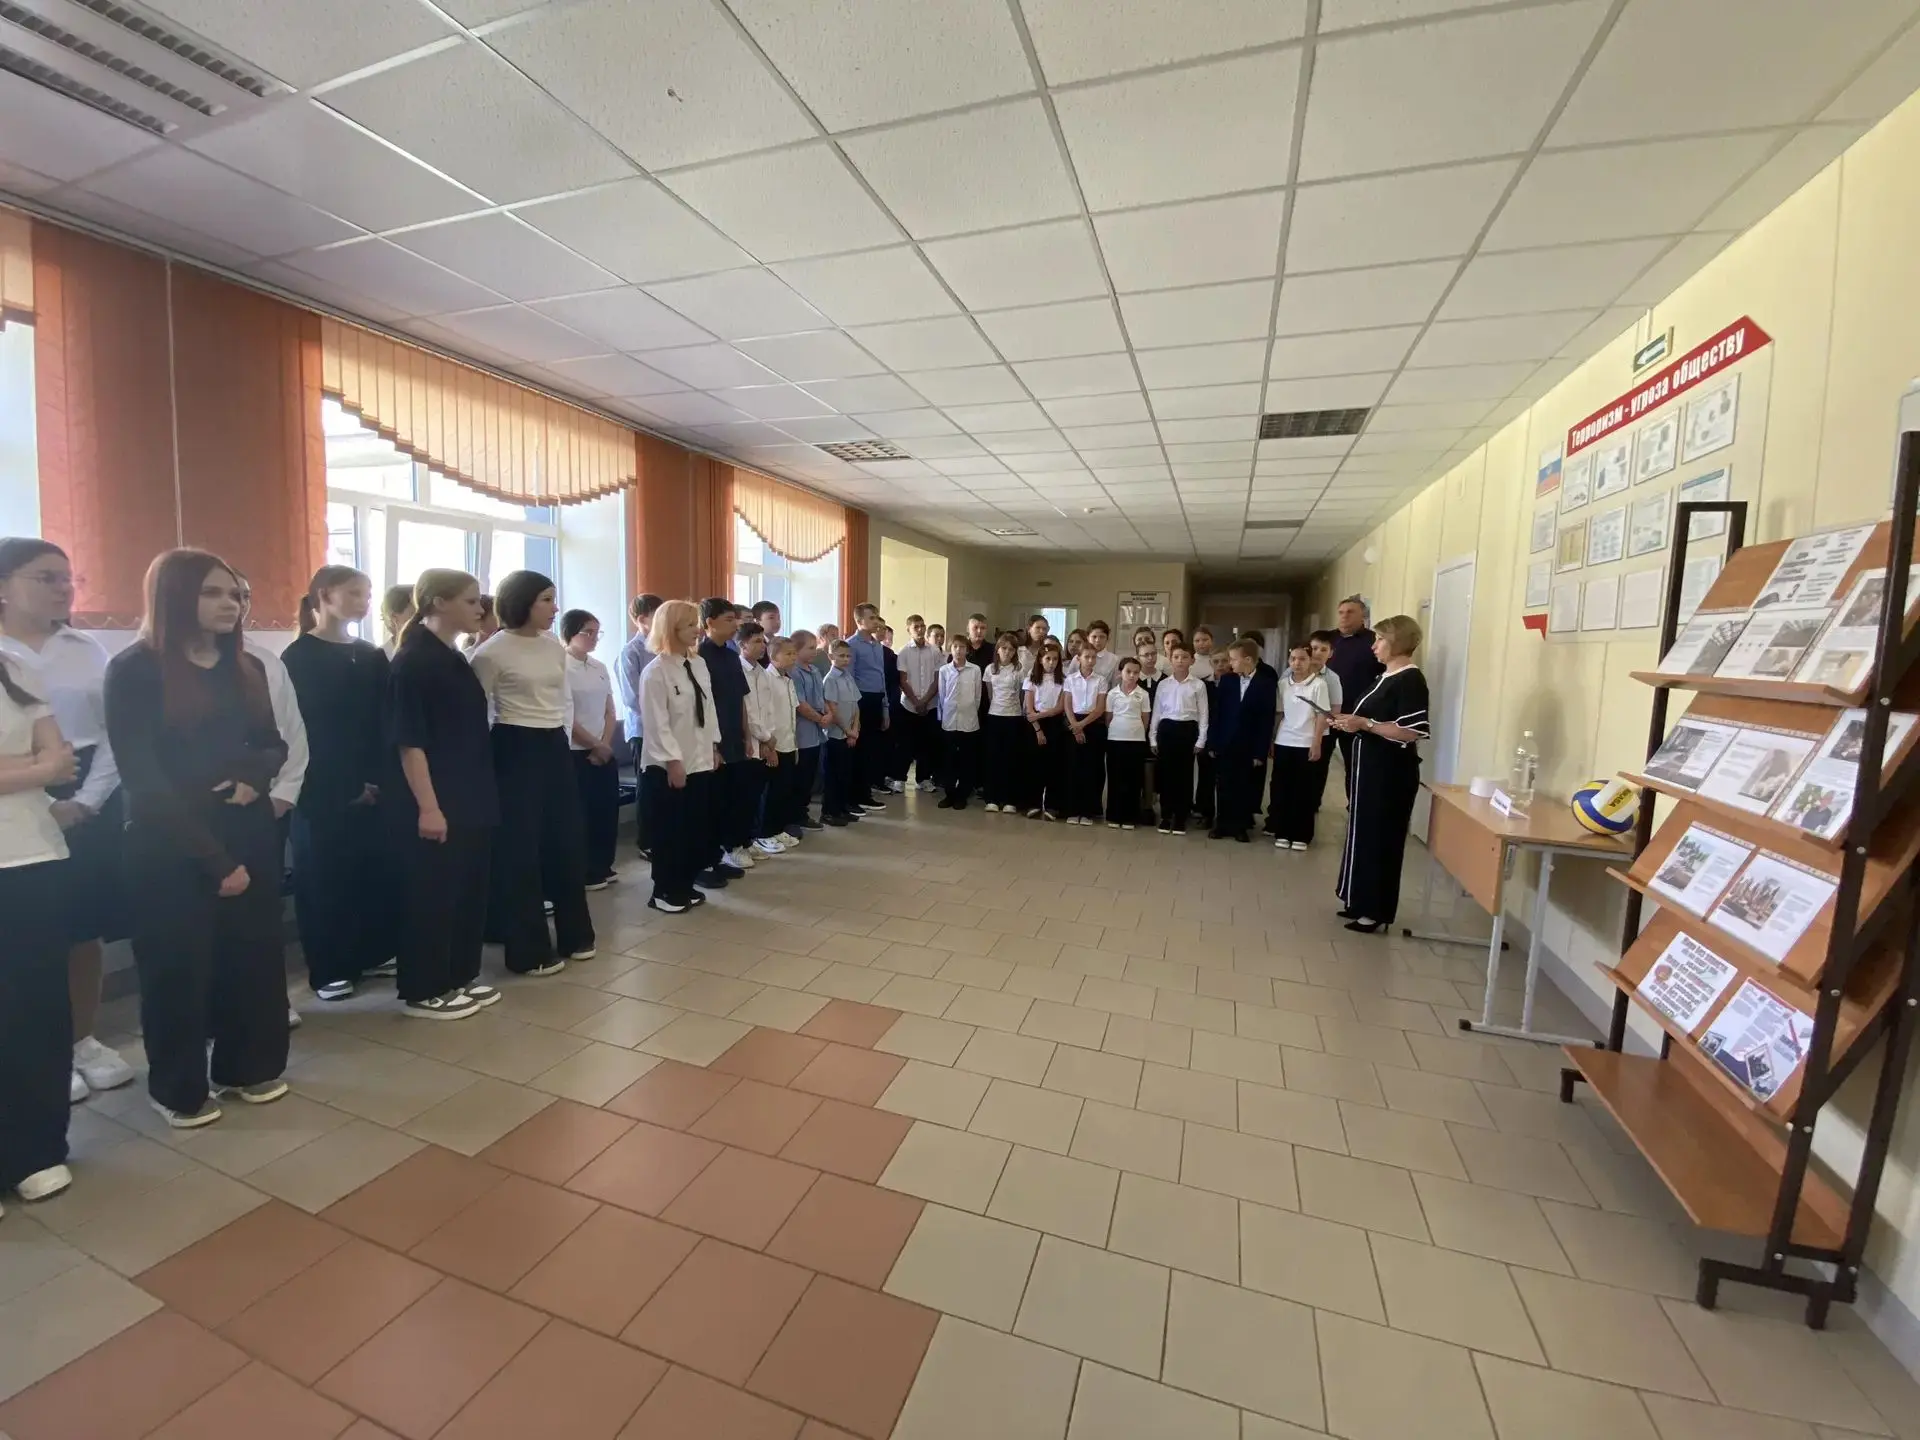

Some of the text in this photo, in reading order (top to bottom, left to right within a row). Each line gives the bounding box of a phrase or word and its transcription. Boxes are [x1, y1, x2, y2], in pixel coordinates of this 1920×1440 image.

[1571, 404, 1624, 449] Терроризм
[1630, 376, 1669, 418] угроза
[1672, 327, 1745, 390] обществу
